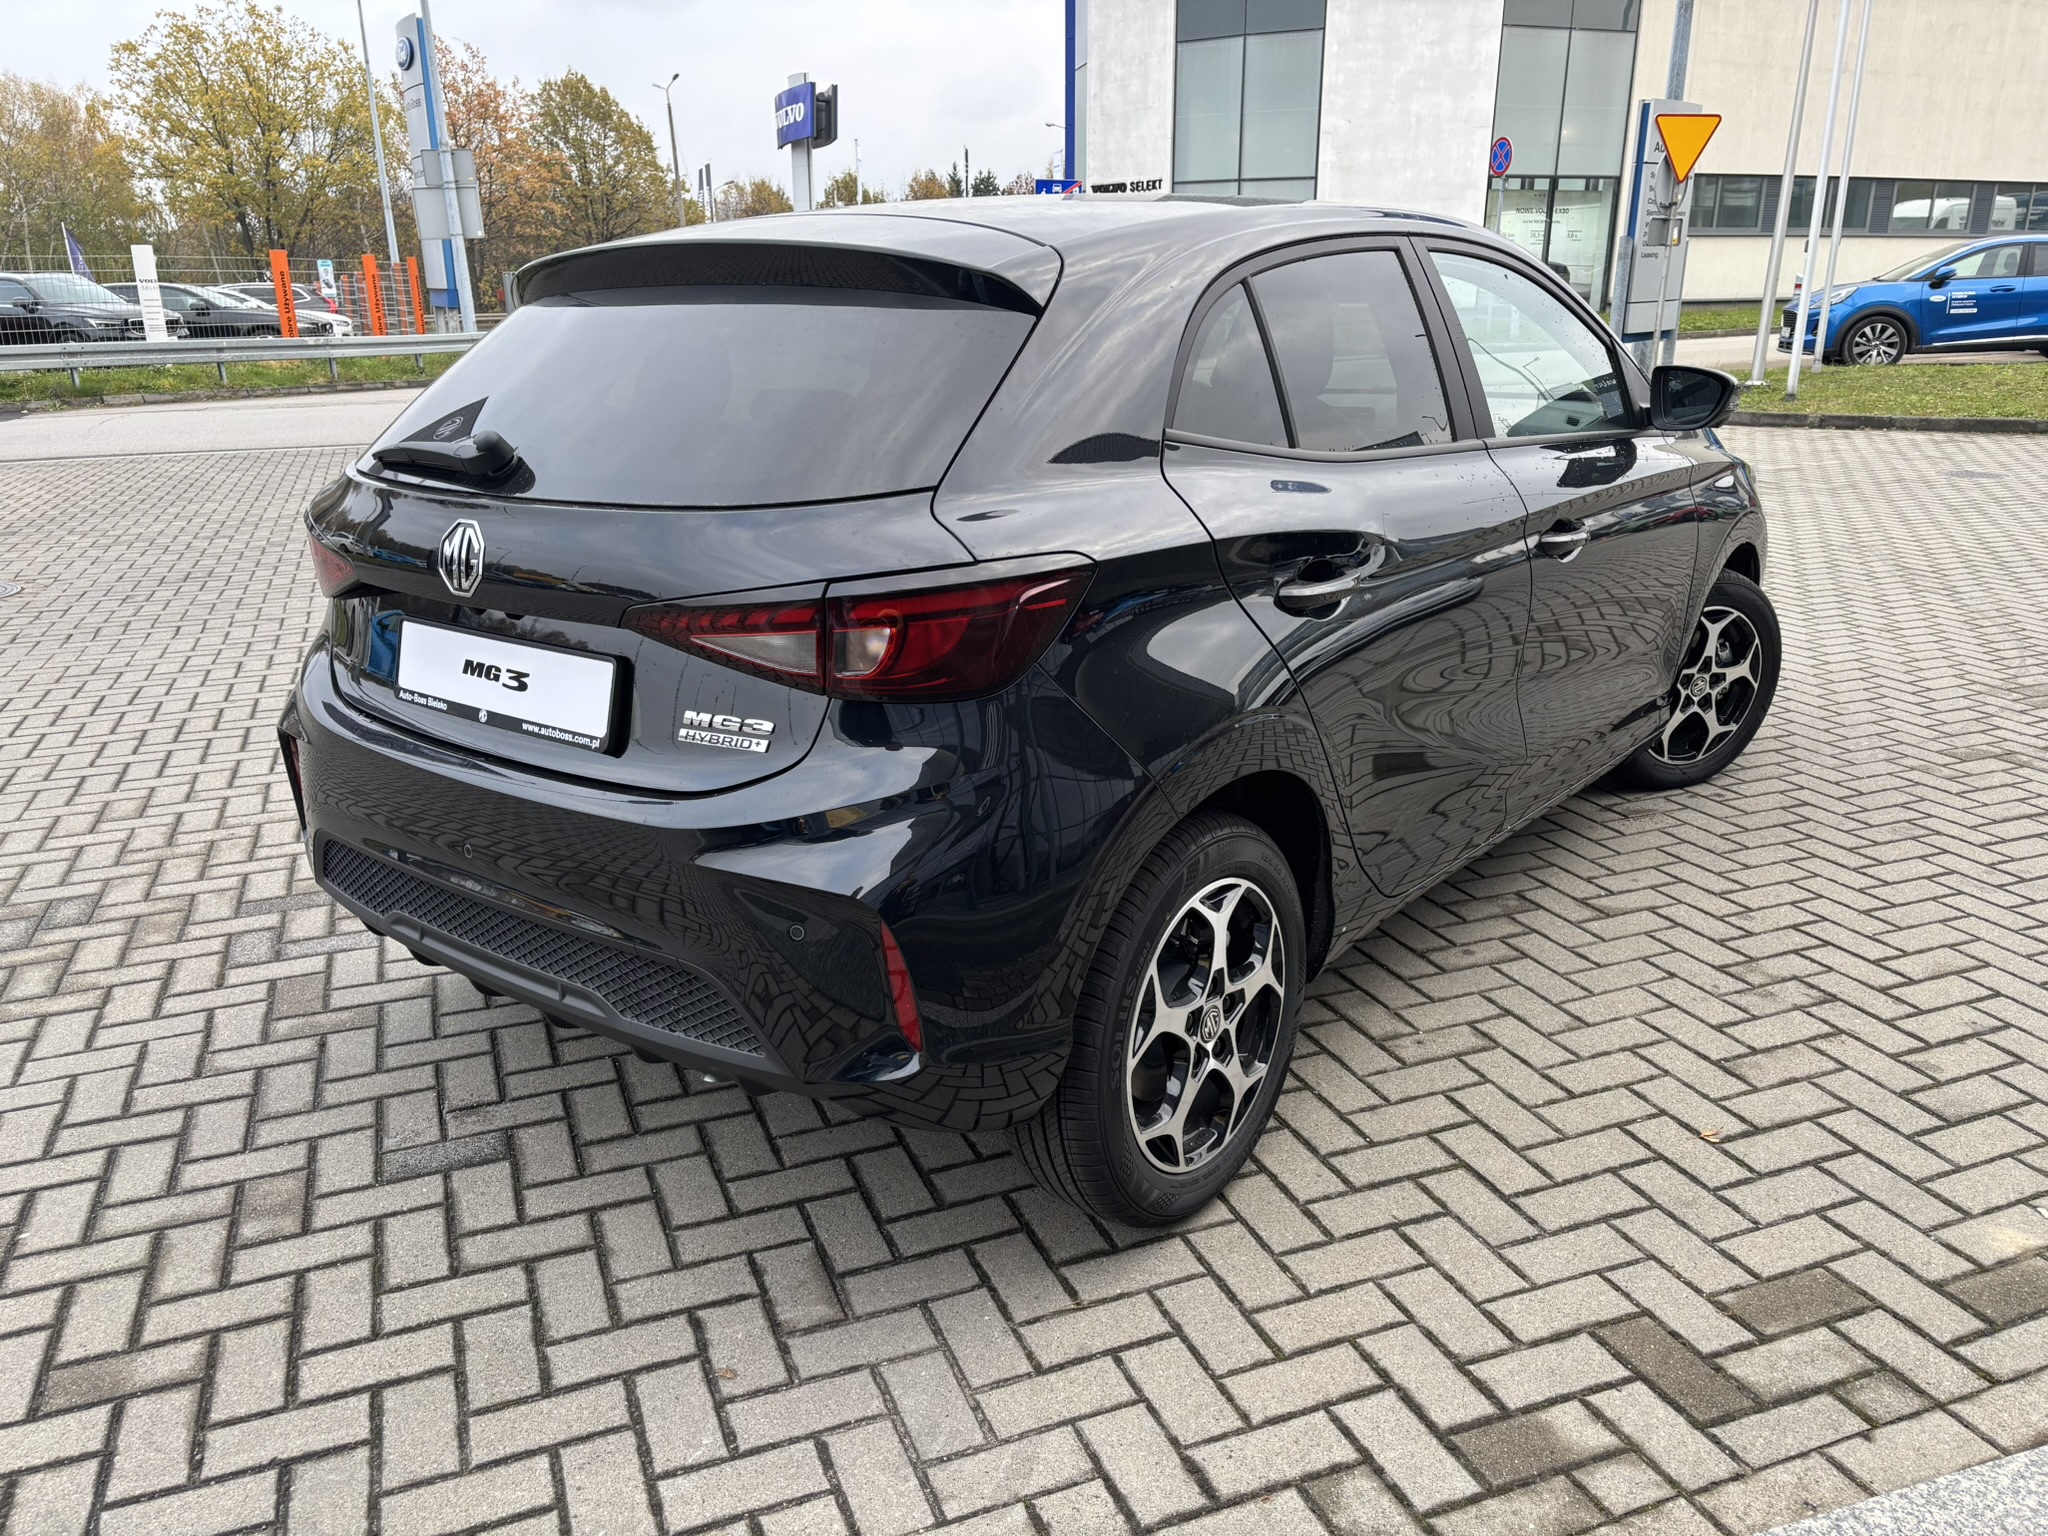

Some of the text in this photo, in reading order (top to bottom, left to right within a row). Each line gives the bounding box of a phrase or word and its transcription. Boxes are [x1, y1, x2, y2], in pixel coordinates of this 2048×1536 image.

[1129, 179, 1163, 193] SELEKT
[287, 316, 295, 338] obre
[442, 525, 480, 591] MG
[462, 659, 530, 692] MG3
[399, 690, 448, 711] Auto-Boss Bielsko
[522, 722, 600, 749] www.autoboss.com.pl
[682, 710, 775, 735] MG3
[1110, 976, 1137, 1091] SOLUS
[1204, 1010, 1219, 1038] MG
